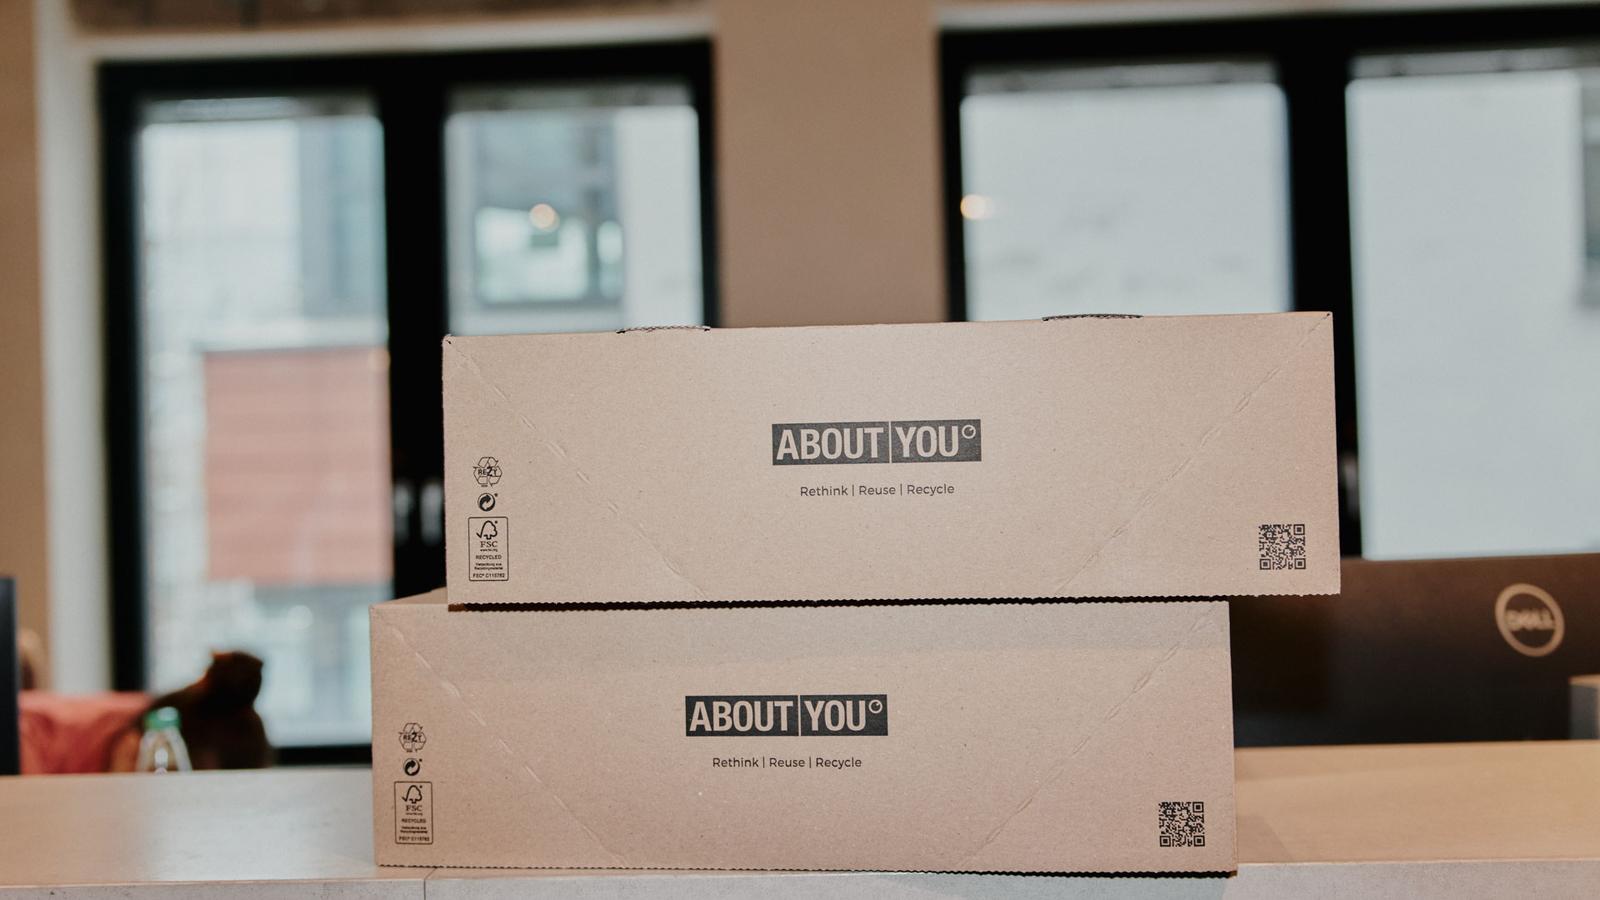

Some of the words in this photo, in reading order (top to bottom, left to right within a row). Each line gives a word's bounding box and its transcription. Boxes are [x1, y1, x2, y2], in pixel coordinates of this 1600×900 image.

[776, 426, 884, 460] ABOUT
[800, 484, 848, 497] Rethink
[858, 485, 896, 496] Reuse
[906, 483, 955, 497] Recycle
[480, 540, 498, 548] FSC
[689, 700, 794, 732] ABOUT
[712, 756, 759, 768] Rethink
[769, 757, 806, 768] Reuse
[815, 756, 862, 770] Recycle
[405, 804, 422, 812] FSC
